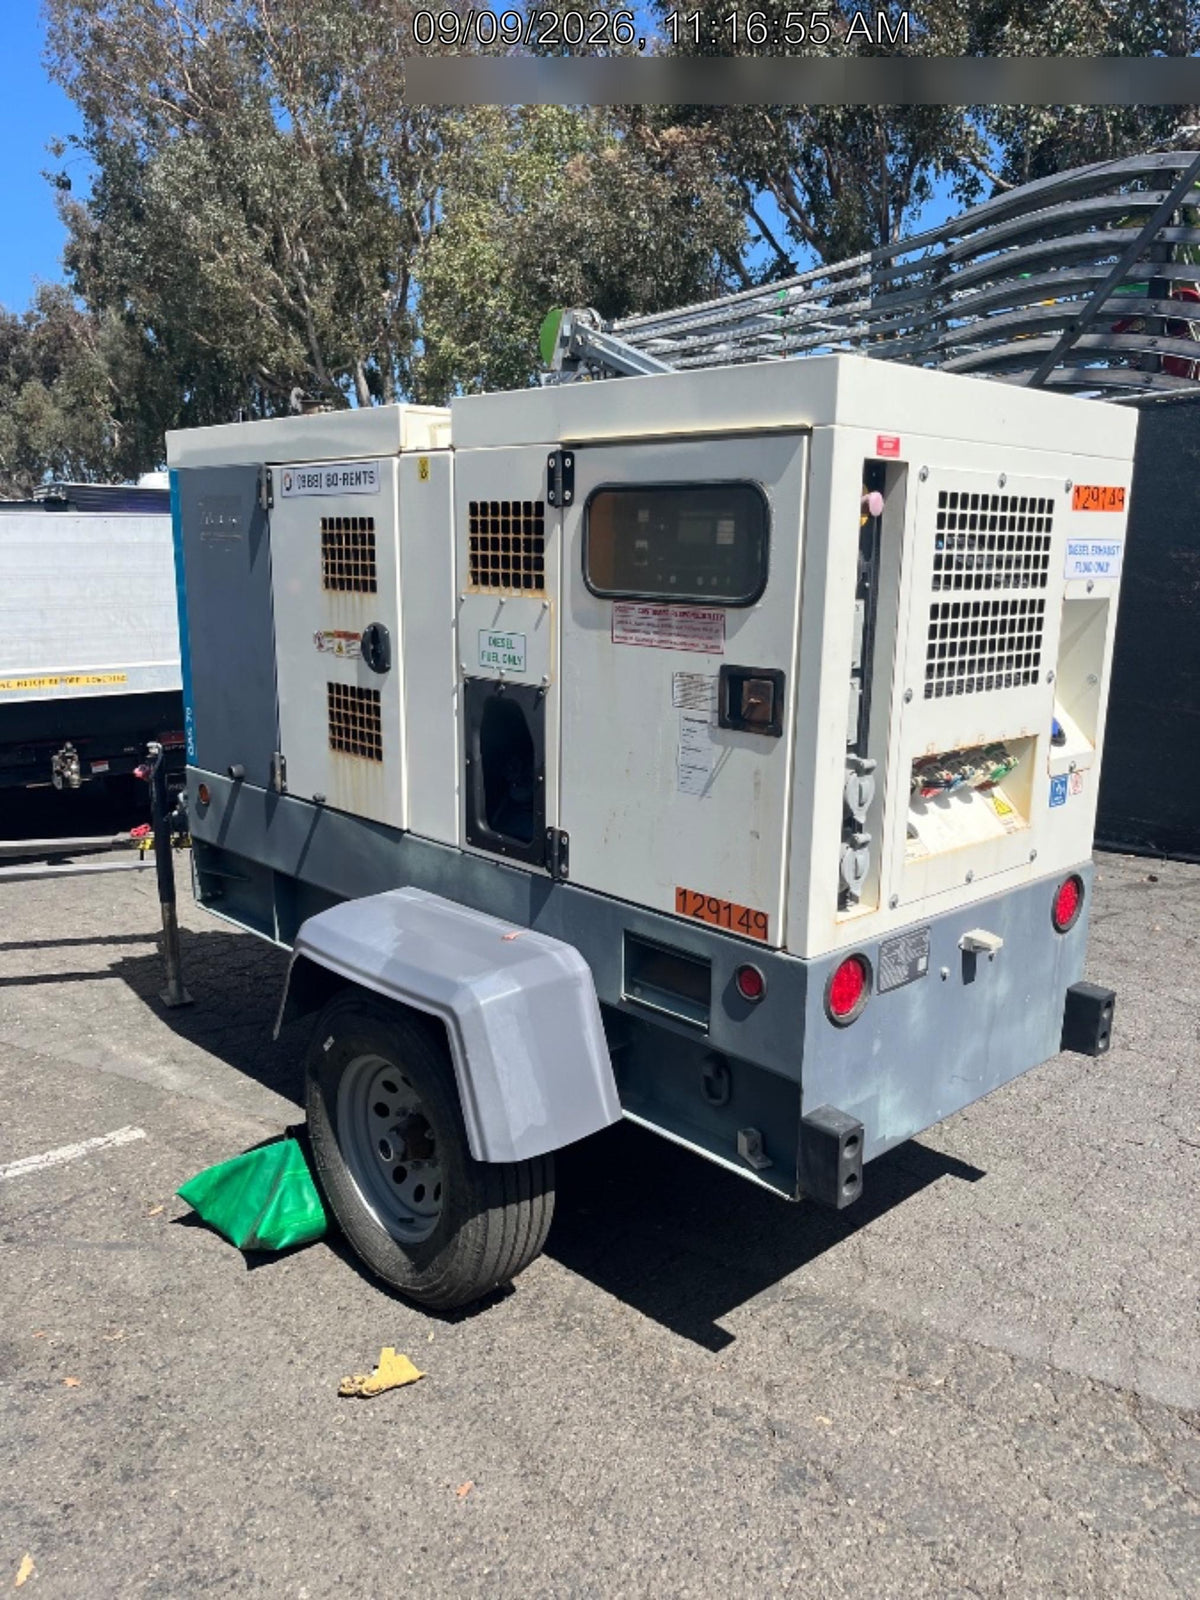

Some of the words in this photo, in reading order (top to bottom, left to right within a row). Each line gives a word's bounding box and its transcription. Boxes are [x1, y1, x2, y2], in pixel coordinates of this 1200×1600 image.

[1074, 486, 1124, 510] 129149
[1091, 544, 1120, 555] EXHAUST
[488, 636, 515, 649] DIESEL
[482, 650, 501, 663] FUEL
[502, 654, 523, 666] ONLY
[678, 889, 768, 941] 129149
